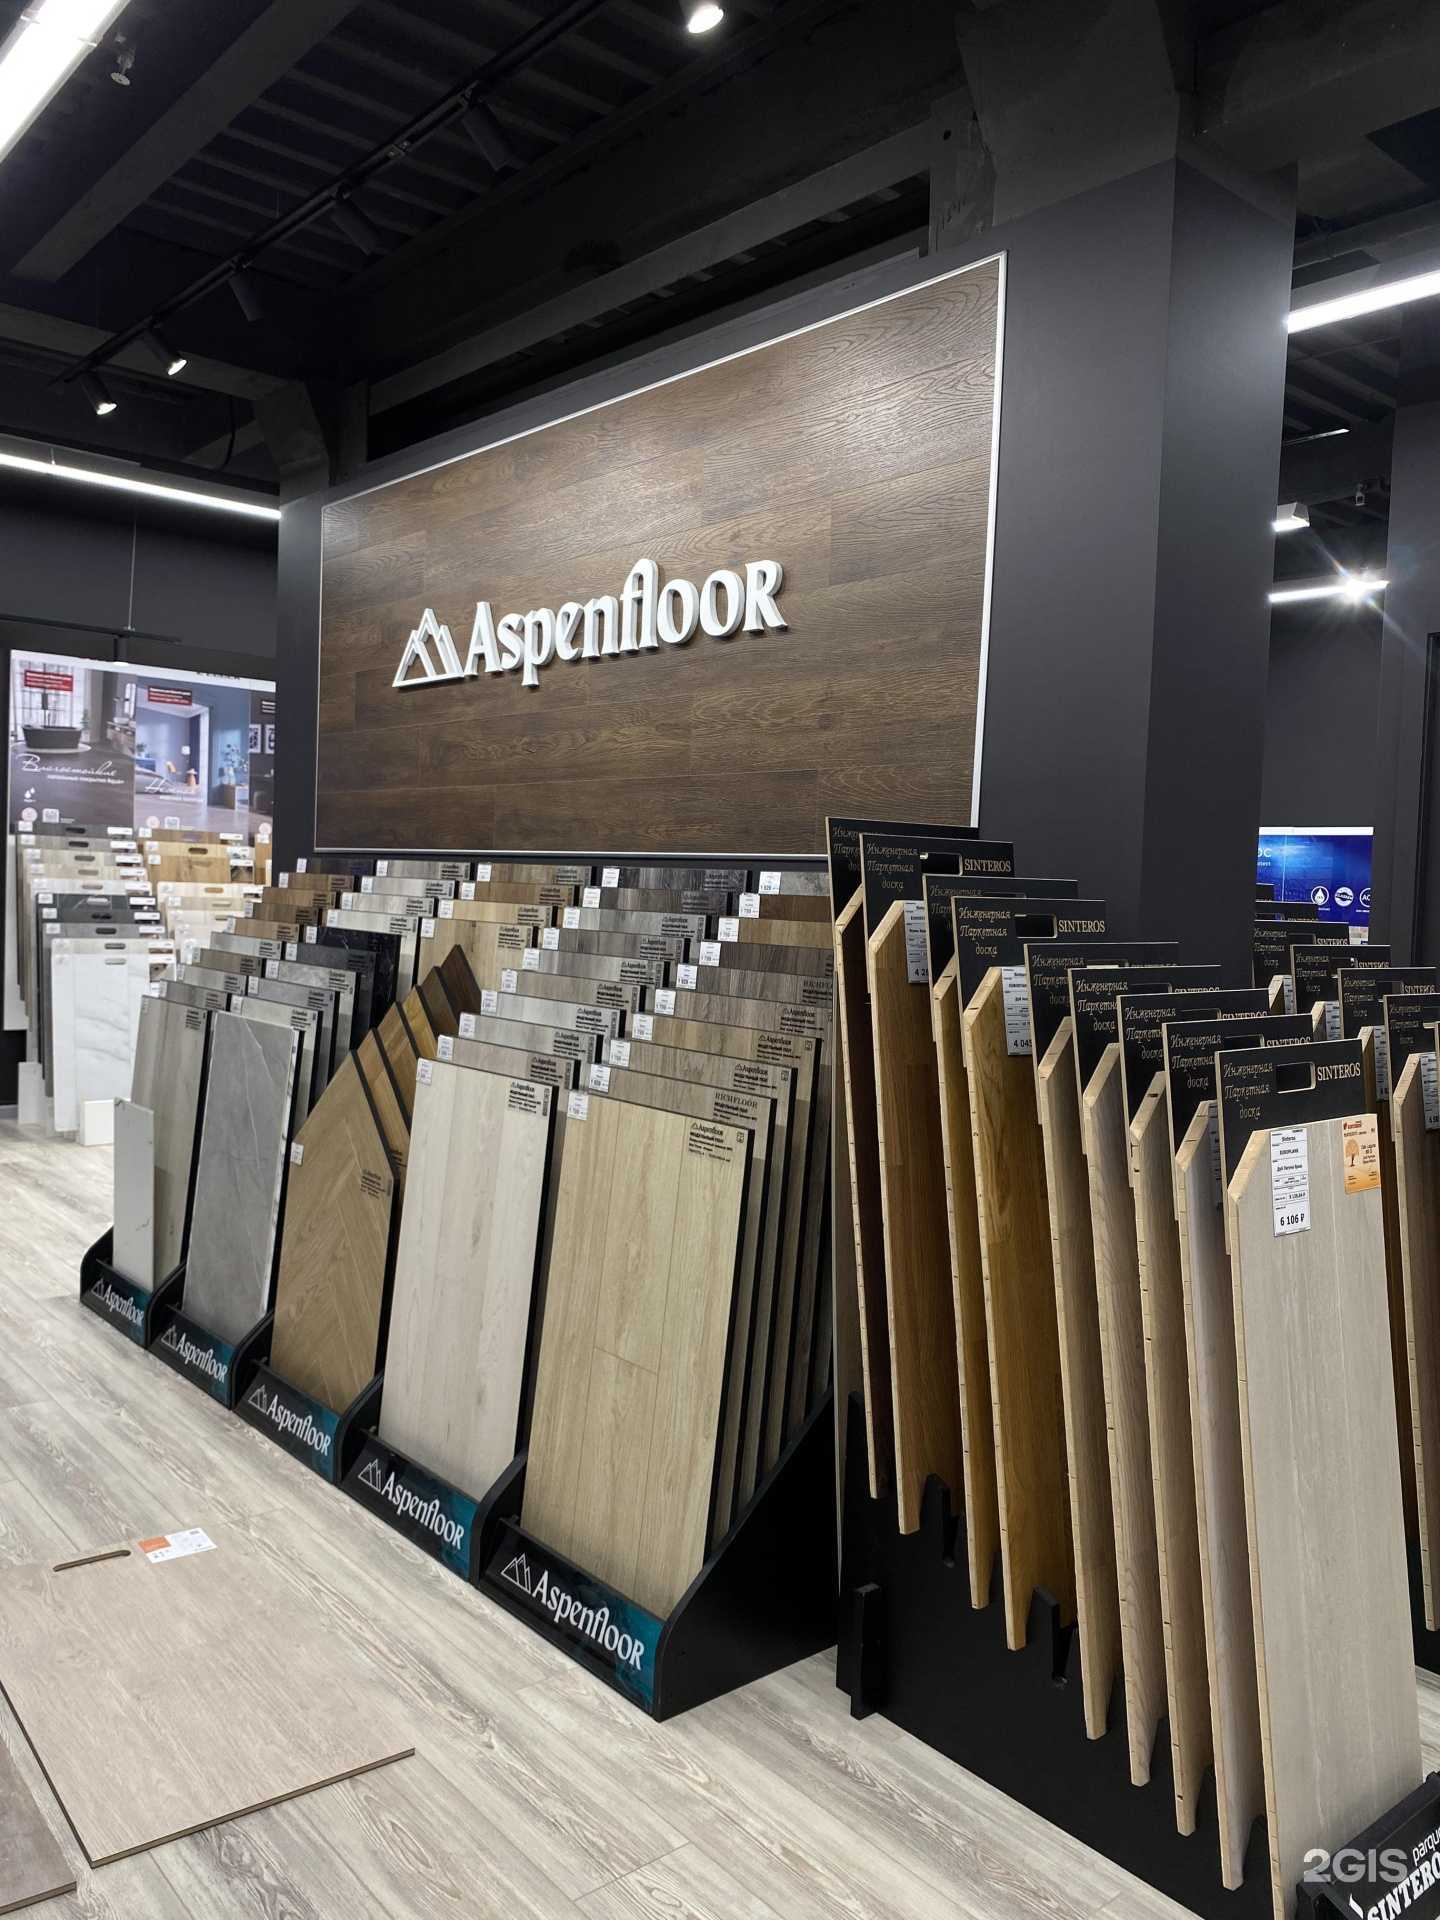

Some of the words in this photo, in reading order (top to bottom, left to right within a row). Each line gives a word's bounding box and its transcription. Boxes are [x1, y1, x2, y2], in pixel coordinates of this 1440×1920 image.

[964, 858, 1012, 873] SINTEROS
[958, 907, 1011, 923] Инженерная
[960, 925, 1008, 941] Паркетная
[1058, 920, 1105, 933] SINTEROS
[975, 943, 998, 958] доска
[1032, 954, 1085, 970] Инженерная
[1076, 978, 1128, 995] Инженерная
[1125, 1008, 1176, 1026] Инженерная
[1171, 1034, 1221, 1052] Инженерная
[1223, 1062, 1273, 1079] Инженерная
[1317, 1062, 1361, 1081] SINTEROS
[1187, 1073, 1209, 1089] доска
[1225, 1084, 1270, 1102] Паркетная
[1239, 1104, 1261, 1120] доска
[1287, 1214, 1299, 1225] 106
